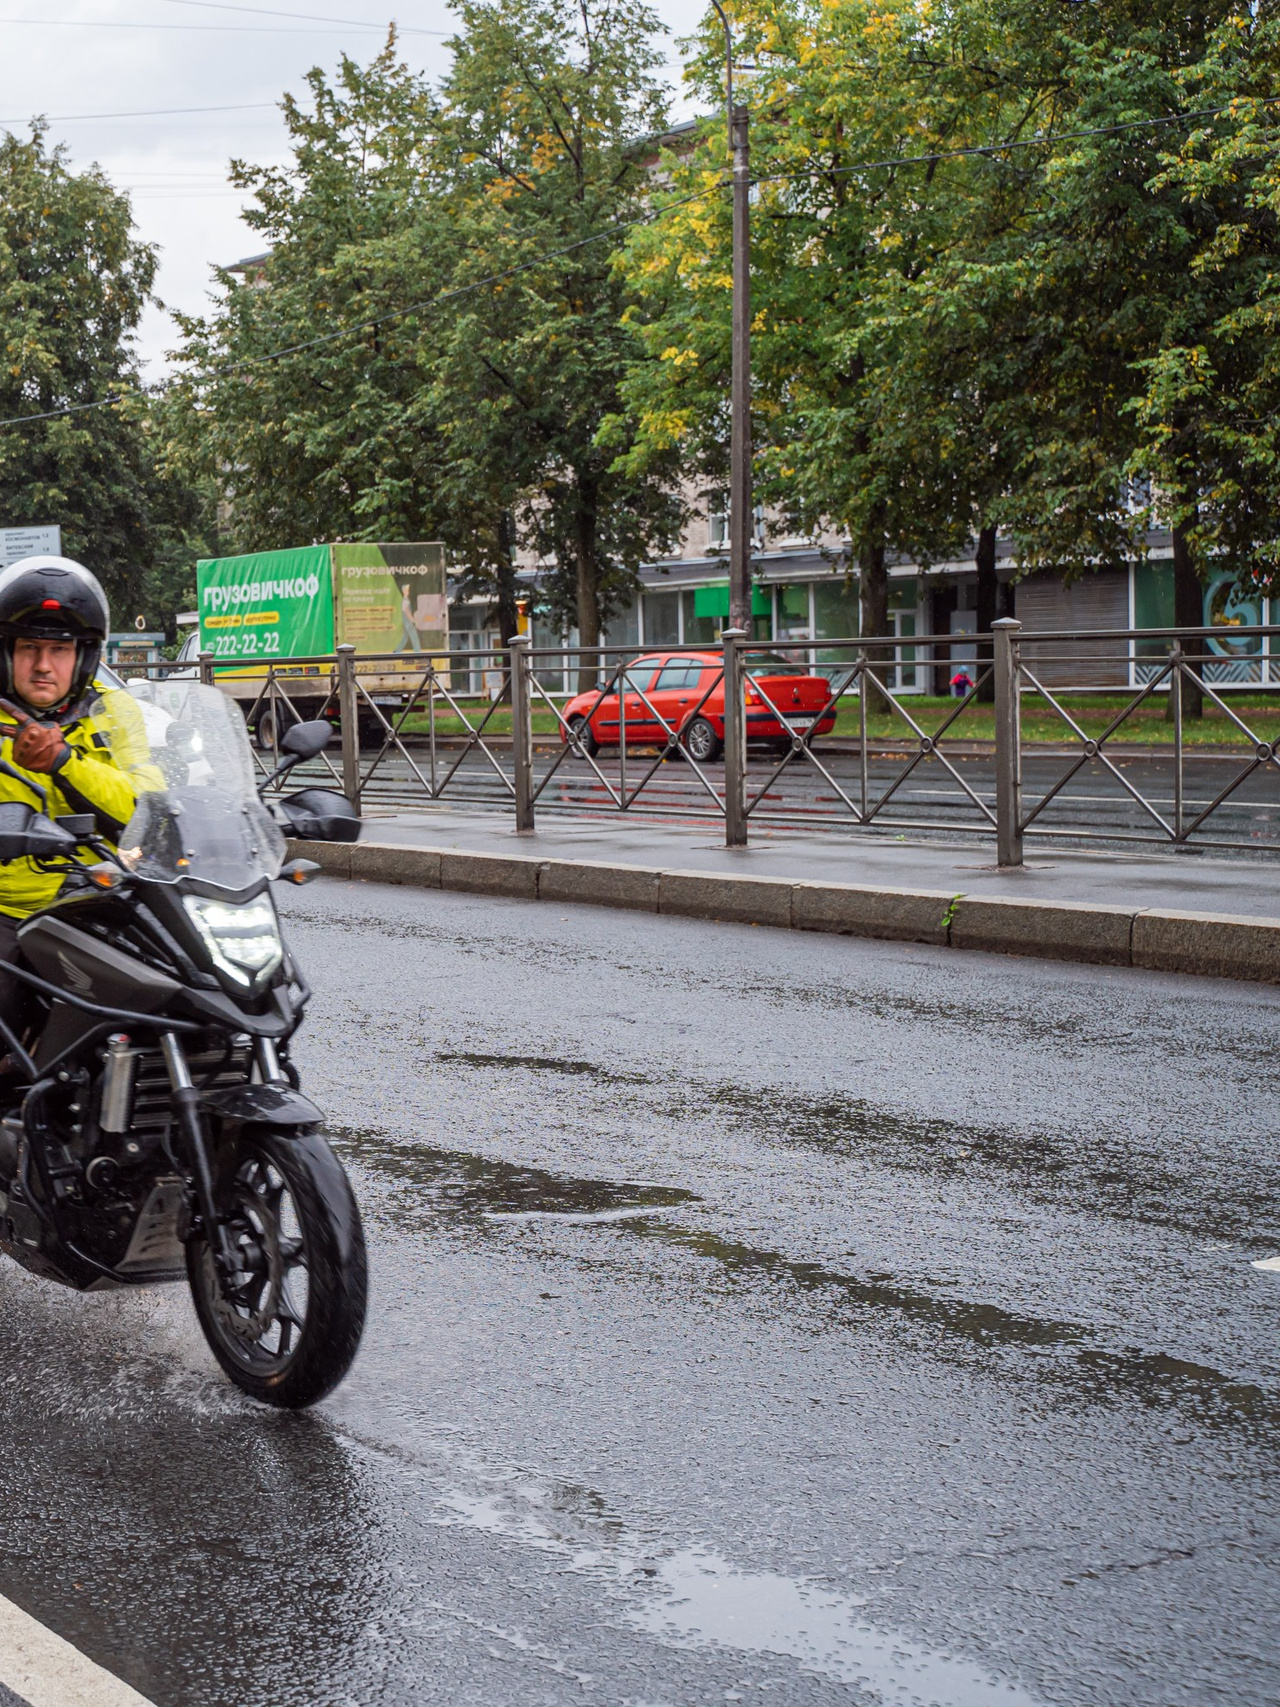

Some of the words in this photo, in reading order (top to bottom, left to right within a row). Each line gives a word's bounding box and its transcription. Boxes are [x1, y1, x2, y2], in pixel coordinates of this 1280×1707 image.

[341, 564, 428, 579] грузовичкоф
[203, 573, 320, 612] грузовичкоф
[215, 632, 280, 656] 222-22-22
